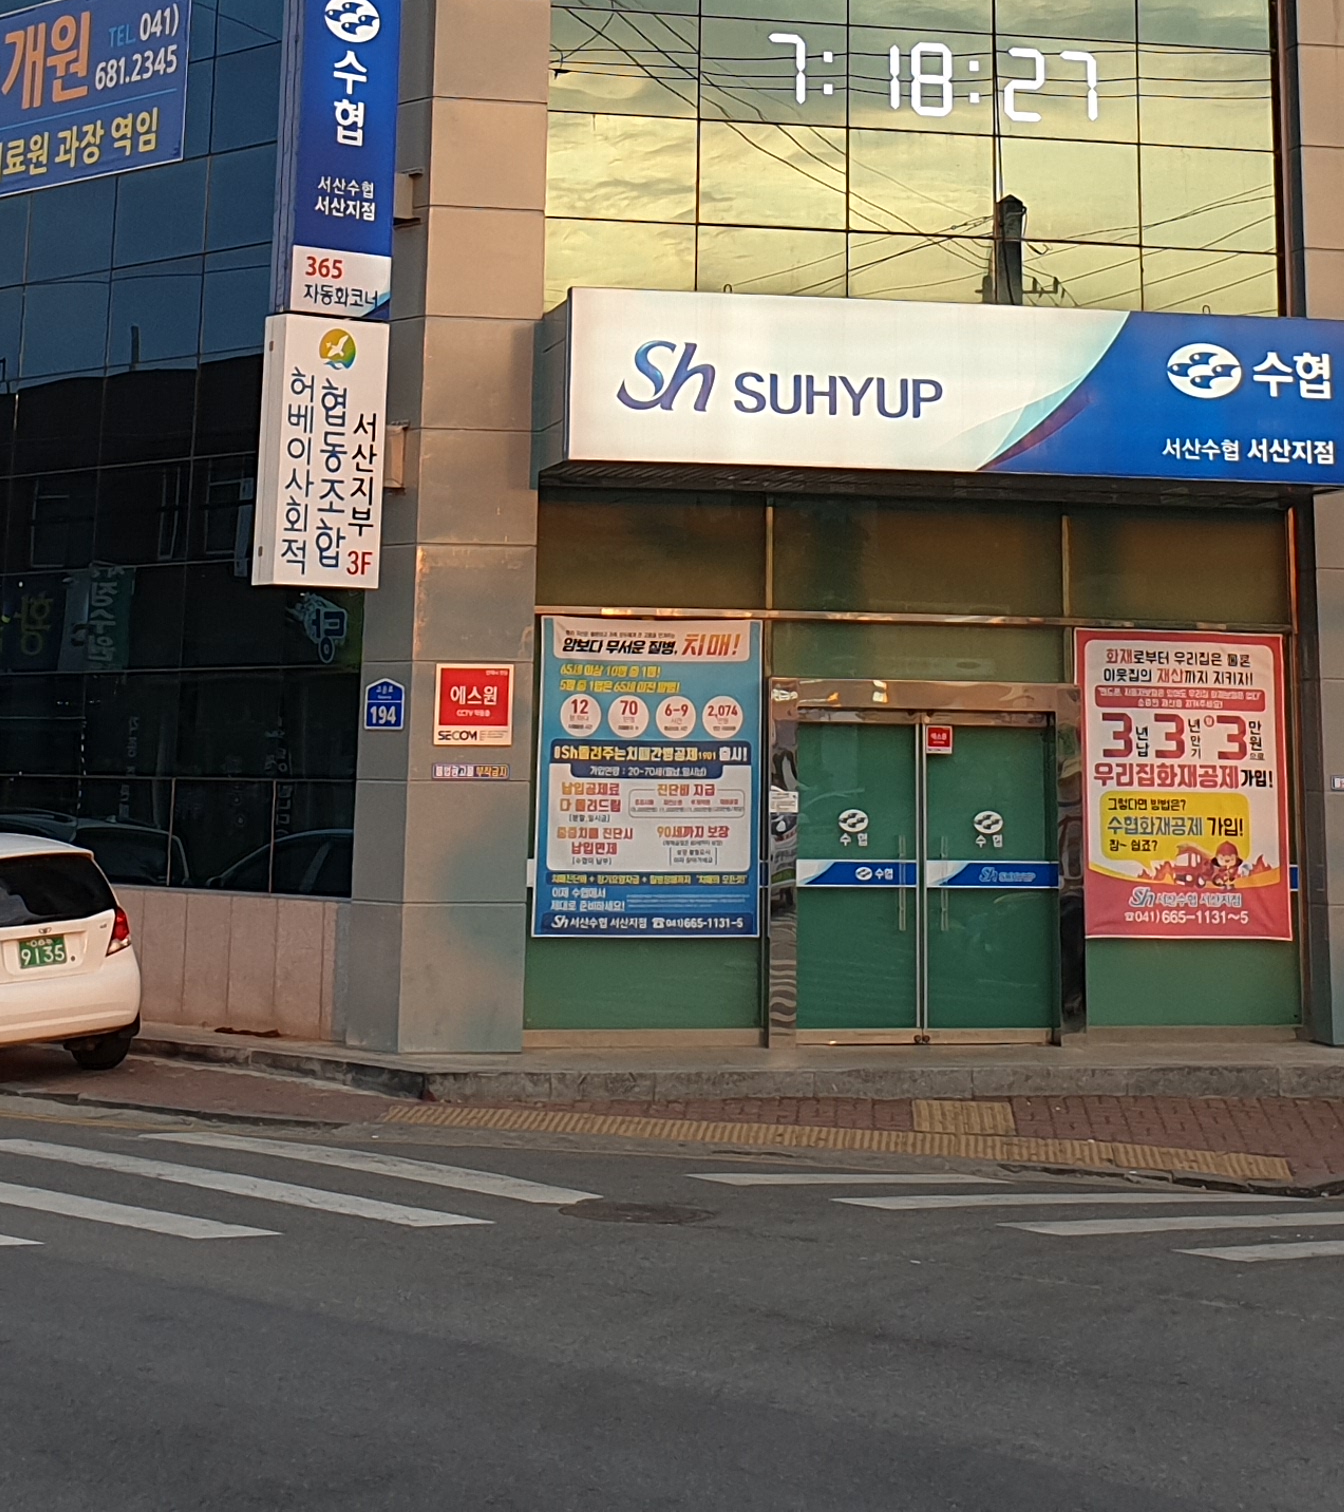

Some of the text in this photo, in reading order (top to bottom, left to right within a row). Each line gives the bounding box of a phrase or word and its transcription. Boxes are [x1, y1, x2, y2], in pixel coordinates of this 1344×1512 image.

[139, 3, 180, 42] 041)
[1, 11, 90, 110] 개원
[95, 44, 178, 90] 681.2345
[332, 51, 368, 147] 수협
[55, 123, 103, 168] 과장
[111, 107, 158, 155] 역임
[318, 175, 374, 199] 서산수협
[314, 197, 376, 221] 서산지점
[305, 256, 343, 279] 365
[303, 284, 378, 308] 자동화코너
[617, 340, 944, 419] Sh SUHYUP
[1252, 350, 1333, 401] 수협
[1162, 437, 1336, 465] 서산수협 서산지점
[281, 367, 315, 575] 허베이사회적
[316, 377, 348, 568] 협동조합
[348, 413, 377, 537] 서산지부
[346, 551, 373, 575] 3F
[562, 637, 603, 653] 암보다
[606, 640, 645, 654] 무서운
[681, 633, 741, 656] 치매!
[1106, 648, 1170, 665] 화재로부터
[1174, 651, 1223, 666] 우리집은
[1103, 668, 1254, 686] 이웃집의 재산까지 지키자!
[450, 686, 497, 705] 에스원
[571, 699, 589, 714] 12
[370, 706, 397, 724] 194
[620, 700, 638, 715] 70
[707, 704, 738, 719] 2,074
[438, 730, 477, 741] SECOM
[1102, 713, 1133, 758] 3
[1154, 713, 1186, 759] 3
[1216, 715, 1247, 761] 3
[693, 783, 716, 796] 지급
[1108, 798, 1147, 810] 그렇다면
[707, 826, 730, 839] 보장
[1107, 816, 1244, 837] 수협화재공제 가입!
[570, 917, 607, 929] 서산수협
[610, 918, 647, 929] 서산지점
[21, 945, 65, 966] 9135
